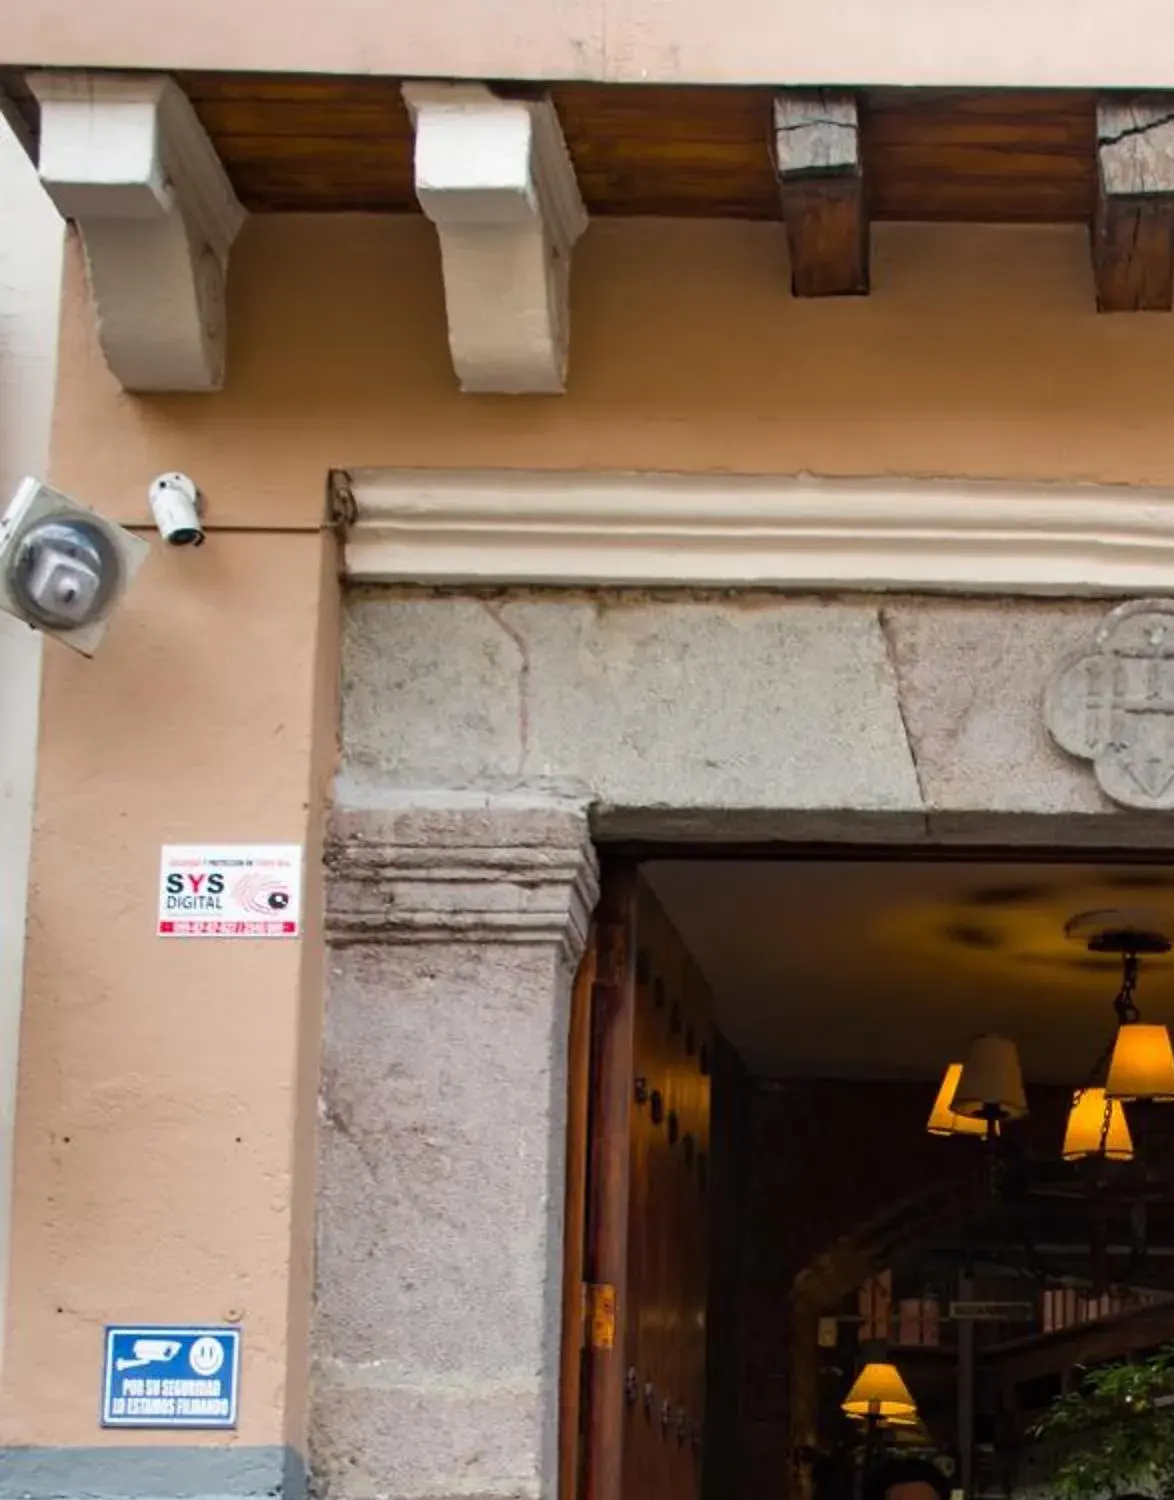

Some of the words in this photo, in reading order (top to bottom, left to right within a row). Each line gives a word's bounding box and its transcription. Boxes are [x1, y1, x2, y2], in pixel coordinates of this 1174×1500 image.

[166, 873, 224, 893] SYS
[166, 896, 223, 909] DIGITAL
[123, 1379, 144, 1396] POR
[146, 1380, 160, 1396] SU
